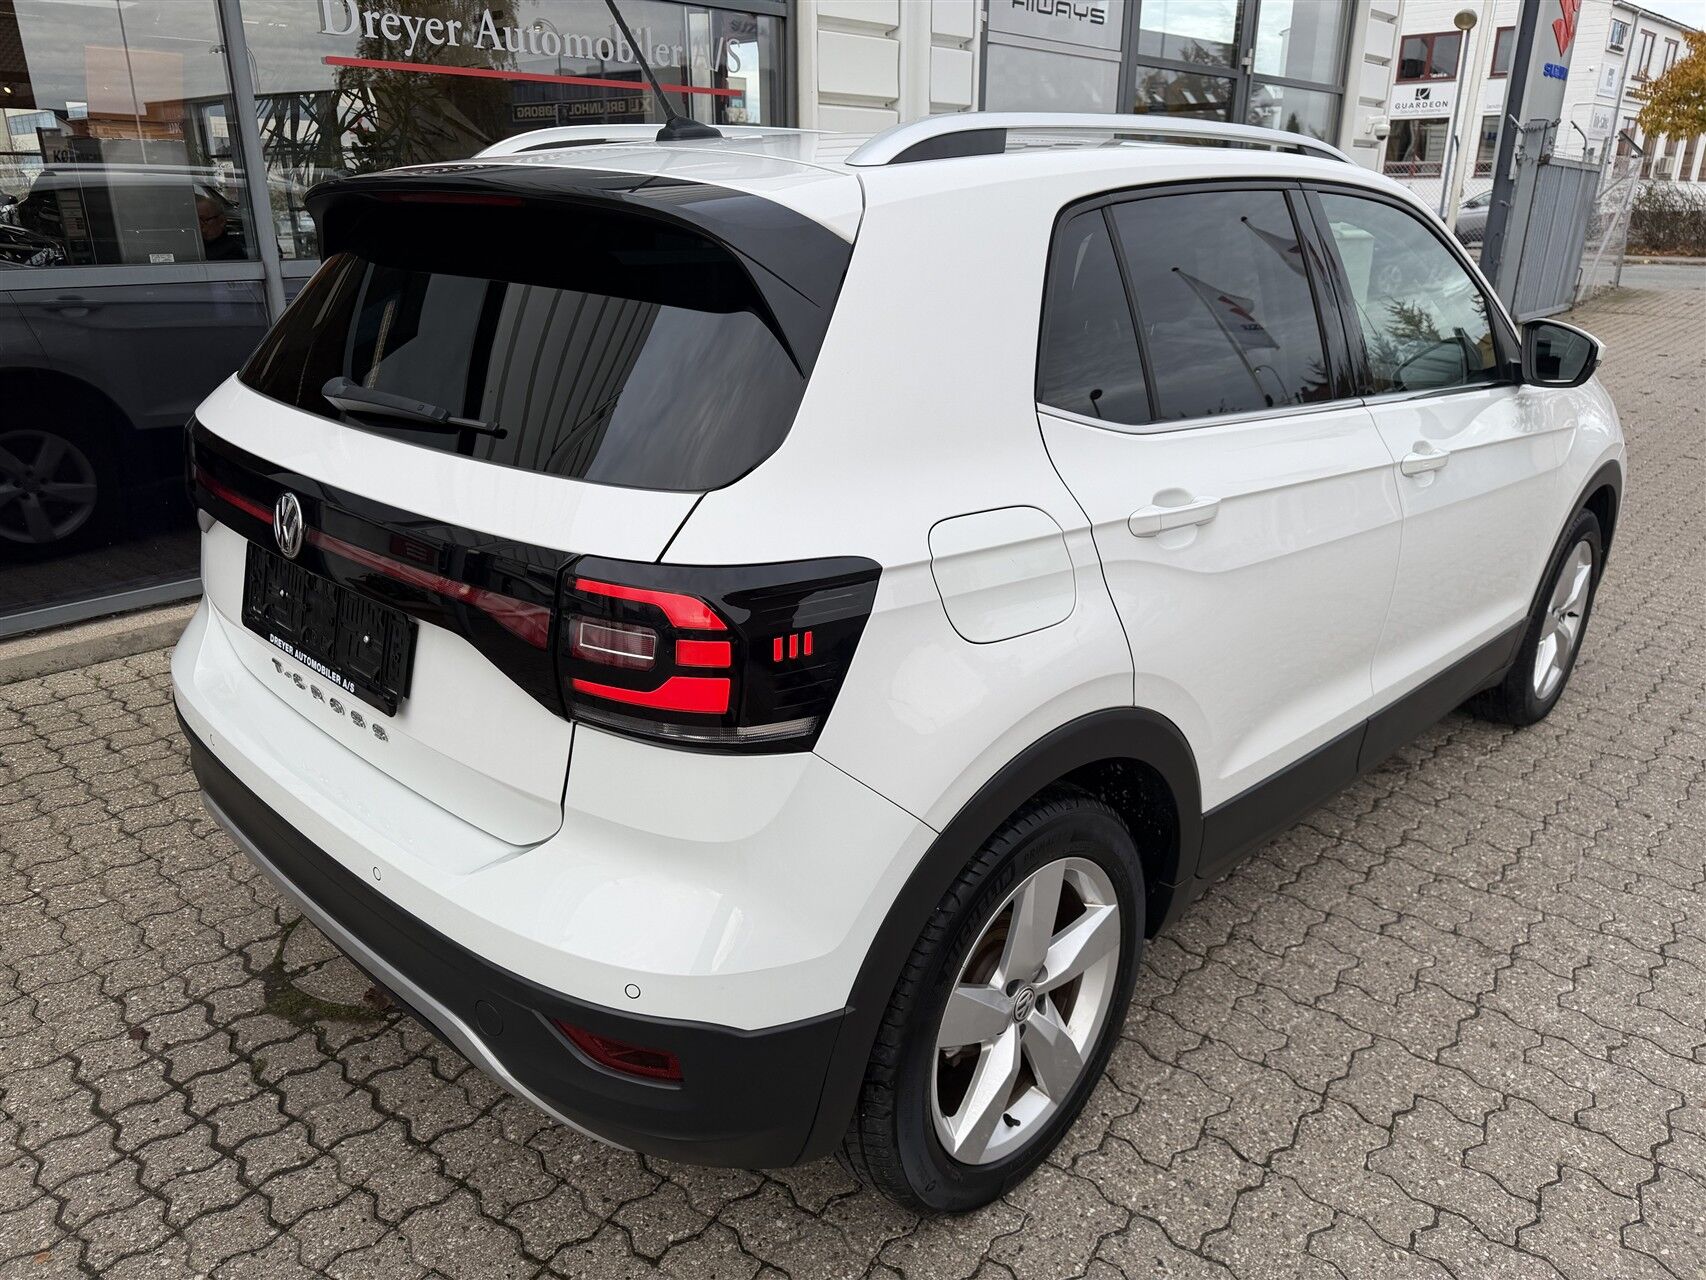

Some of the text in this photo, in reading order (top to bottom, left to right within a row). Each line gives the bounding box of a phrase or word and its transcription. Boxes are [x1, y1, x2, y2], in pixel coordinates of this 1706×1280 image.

[321, 0, 741, 73] Dreyer Automobiler A/S
[1394, 101, 1449, 110] GUARDEON
[269, 633, 355, 693] DREYER AUTOMOBILER A/S
[271, 657, 389, 742] T-CROSS
